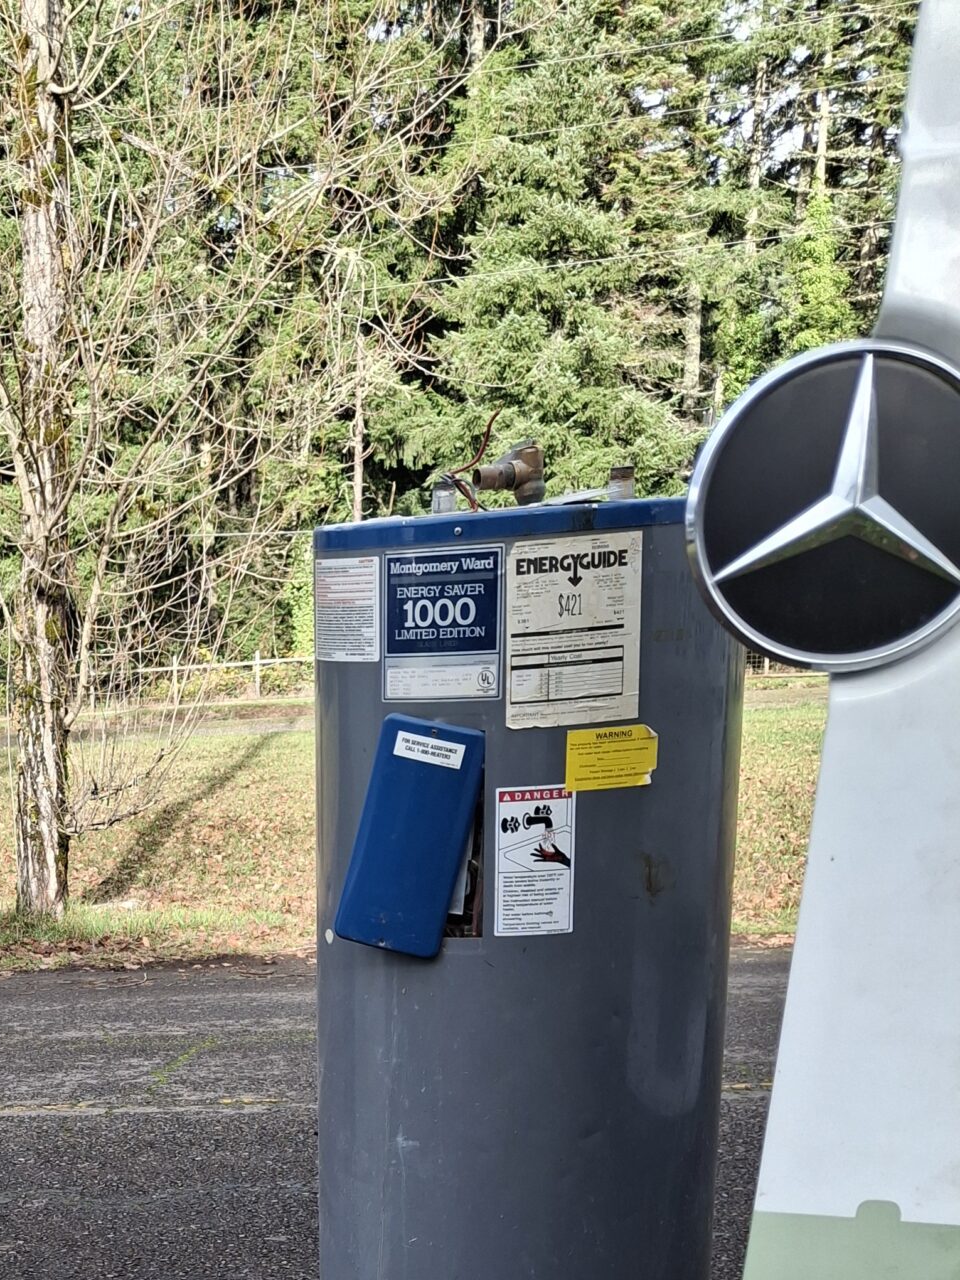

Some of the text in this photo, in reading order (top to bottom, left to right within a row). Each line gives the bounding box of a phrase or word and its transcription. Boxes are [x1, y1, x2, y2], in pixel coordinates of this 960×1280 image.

[390, 555, 494, 576] Montgomery Ward
[516, 549, 628, 576] ENERGYGUIDE
[396, 583, 485, 598] ENERGY SAVER
[403, 597, 476, 627] 1000
[558, 593, 582, 618] $421
[395, 626, 485, 640] LIMITED EDITION
[596, 729, 633, 739] WARNING
[405, 745, 416, 753] CALL
[411, 739, 430, 748] SERVICE
[430, 744, 458, 754] ASSISTANCE
[515, 789, 569, 801] DANGER
